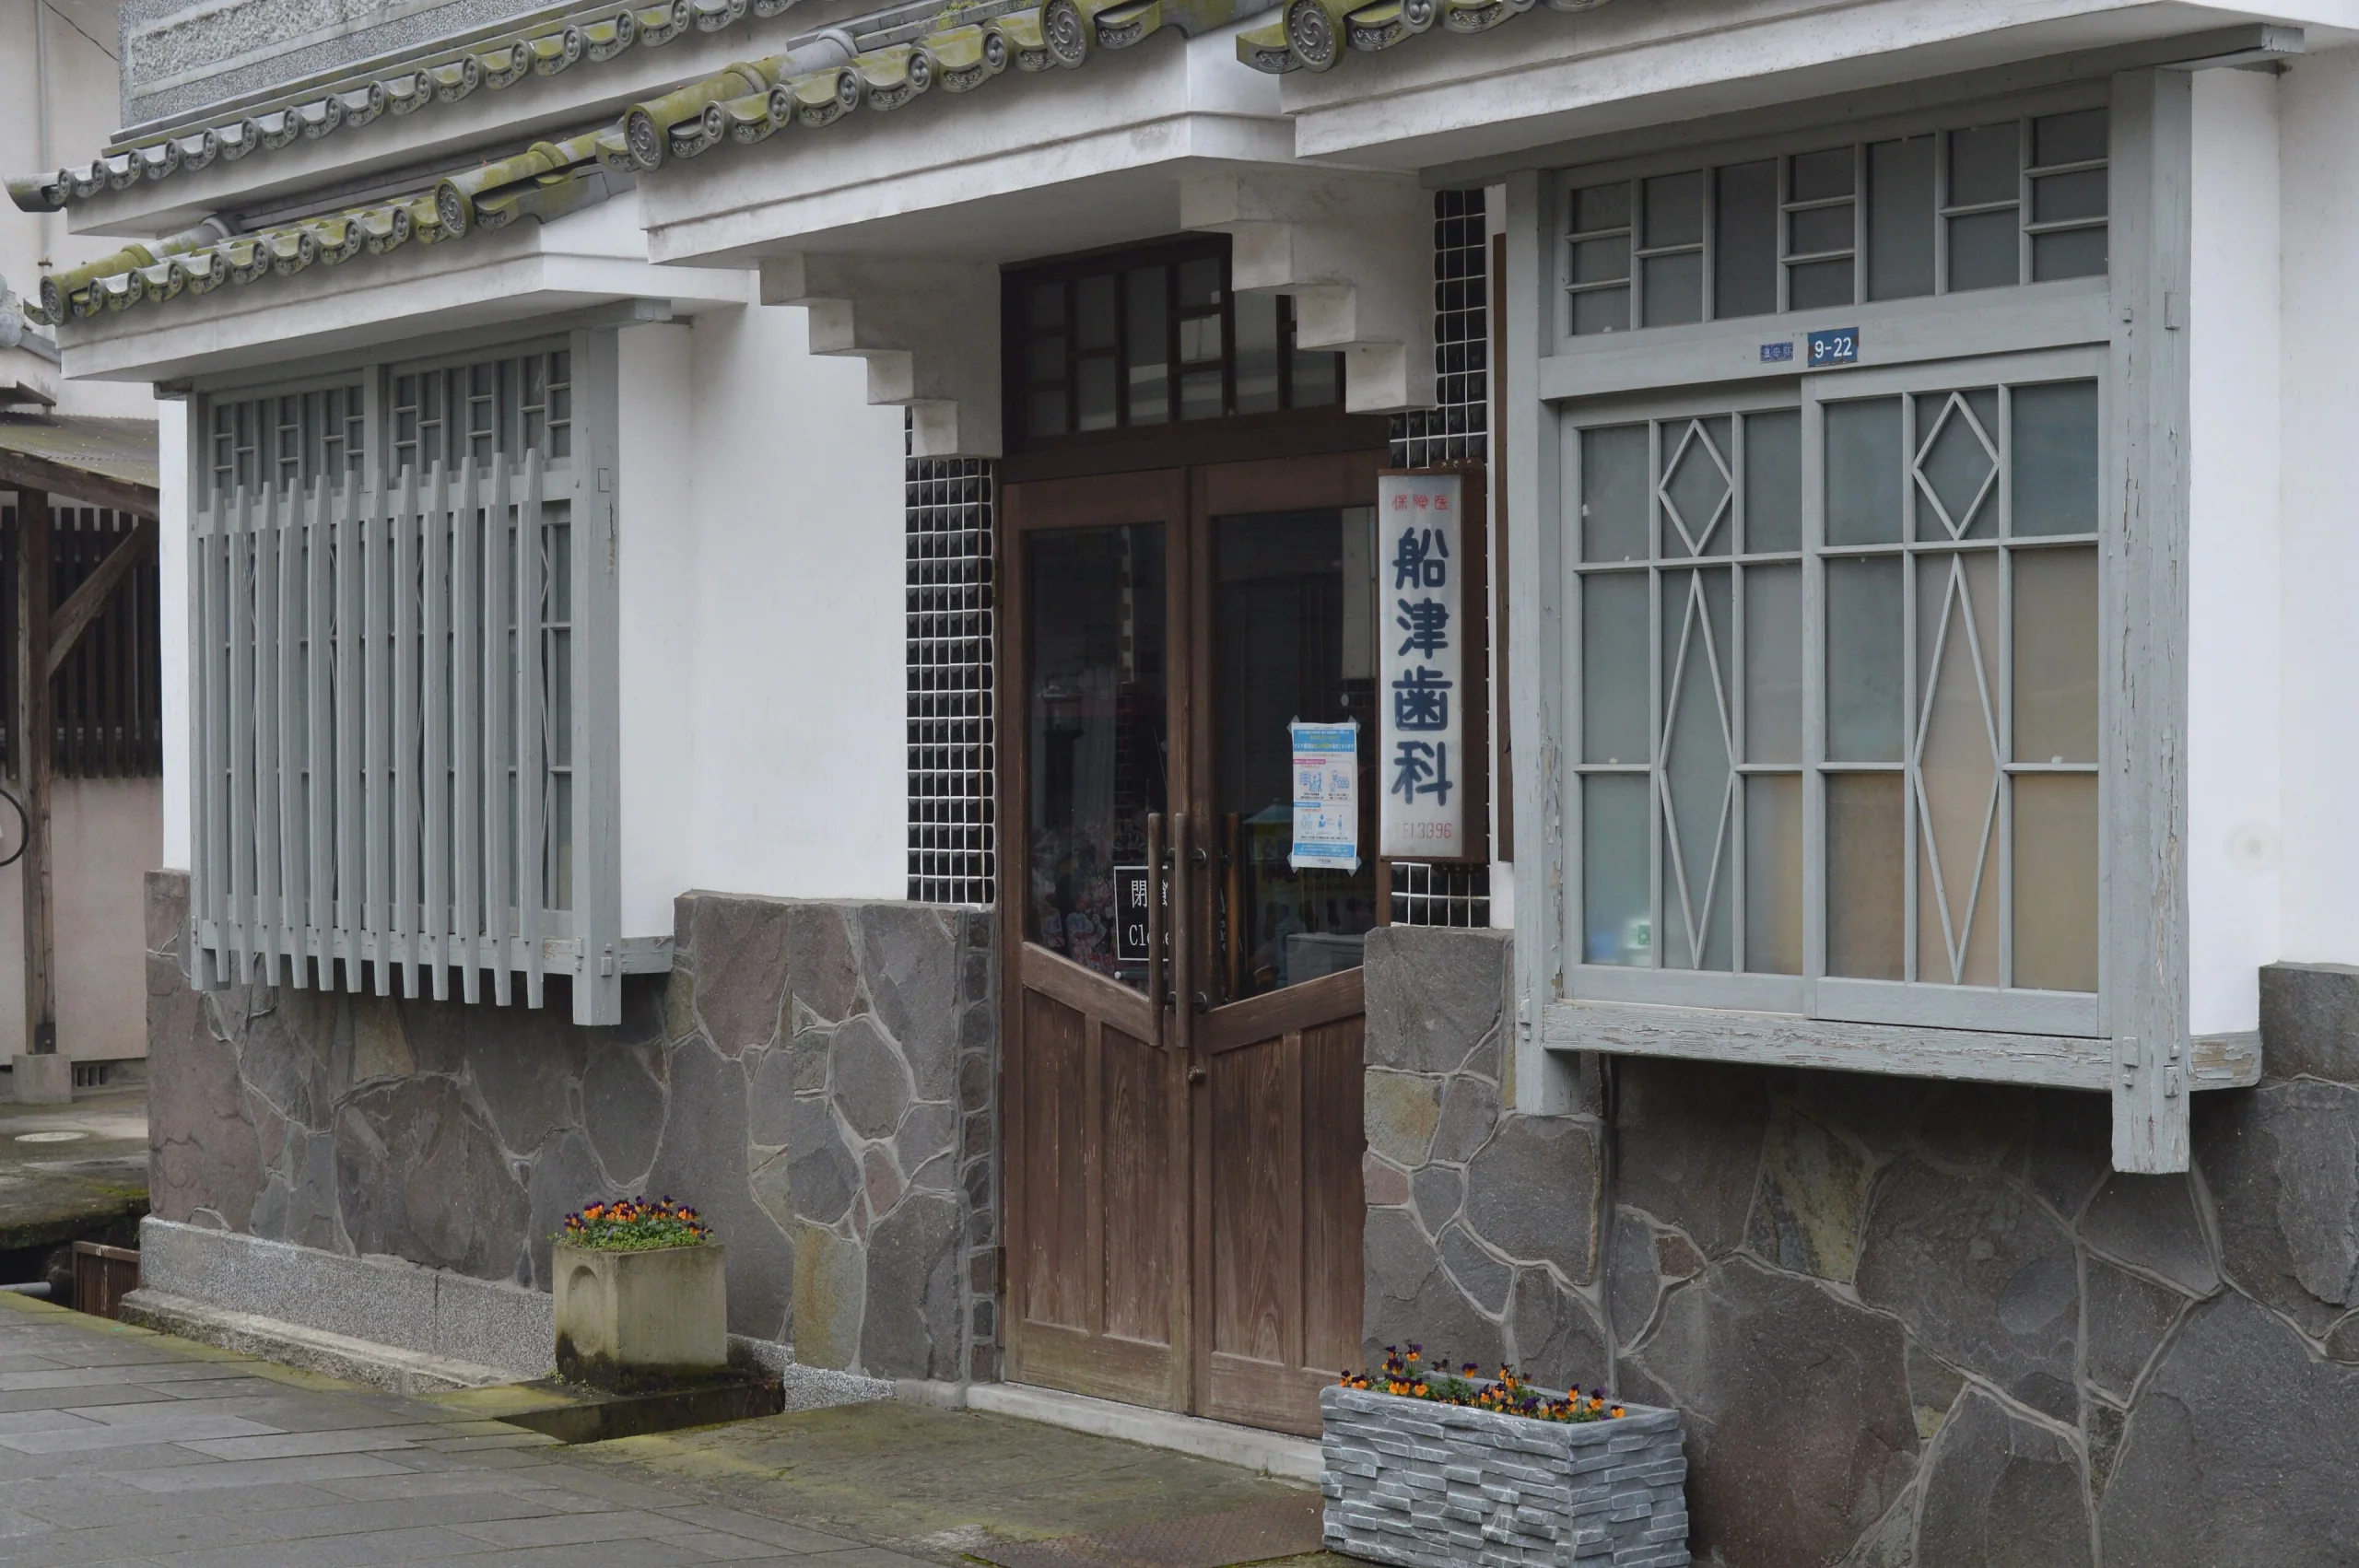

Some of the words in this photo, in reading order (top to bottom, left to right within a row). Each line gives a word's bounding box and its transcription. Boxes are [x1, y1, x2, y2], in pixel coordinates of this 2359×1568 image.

[1814, 337, 1852, 358] 9-22
[1392, 494, 1449, 511] 保険医
[1391, 526, 1453, 807] 船津歯科
